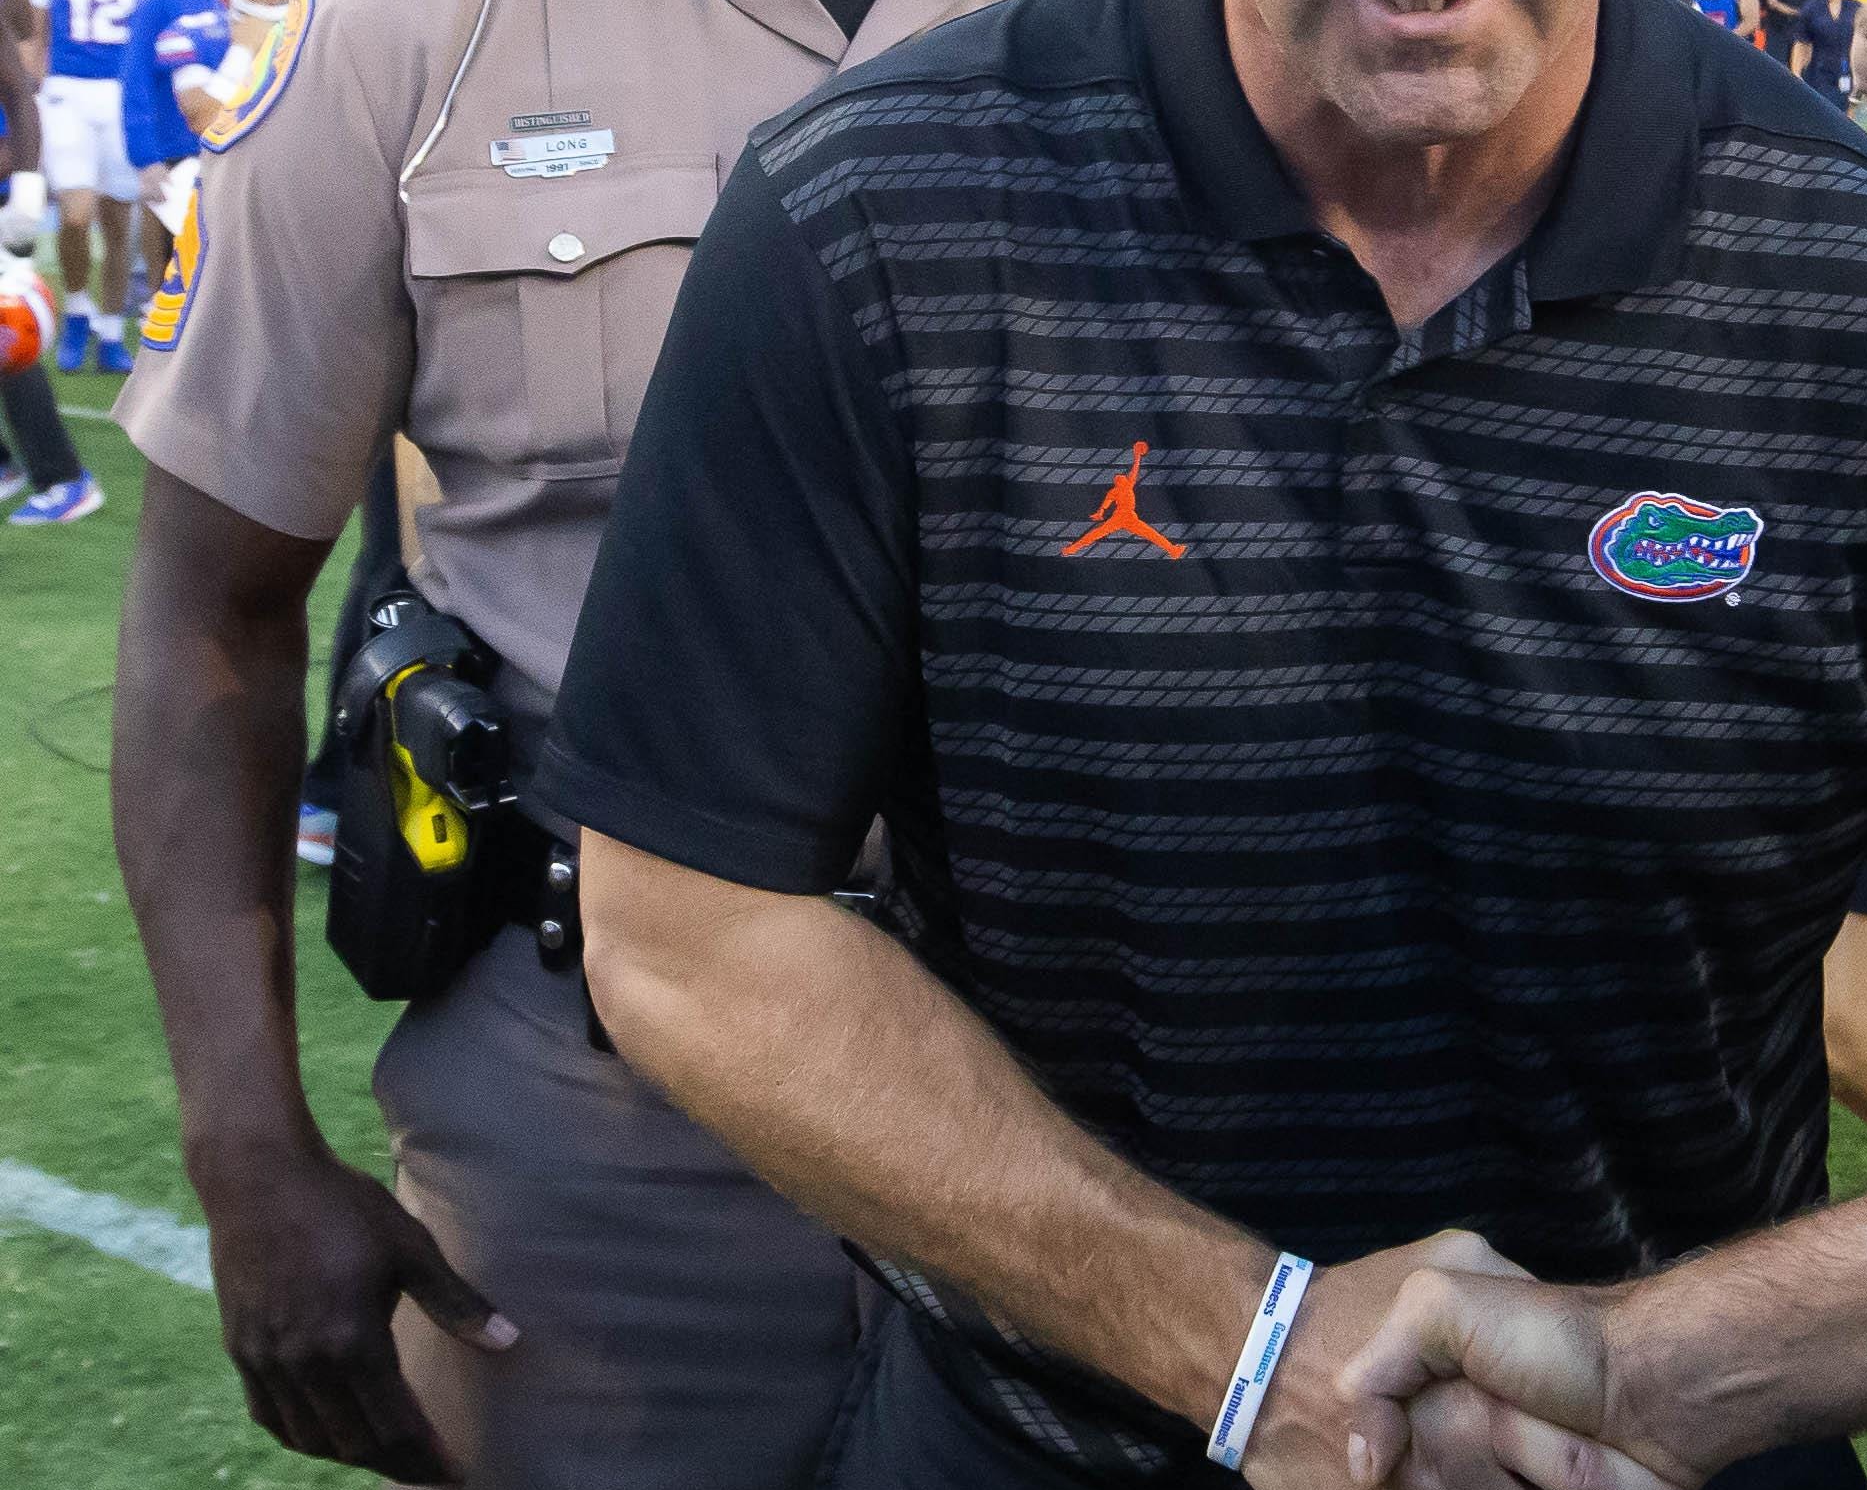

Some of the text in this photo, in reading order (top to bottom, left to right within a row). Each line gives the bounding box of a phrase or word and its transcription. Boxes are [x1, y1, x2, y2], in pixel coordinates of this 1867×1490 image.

[512, 112, 590, 128] DISTINGUISHED
[545, 138, 588, 152] LONG
[1263, 1263, 1293, 1317] Kindness
[1253, 1321, 1287, 1386] Goodness
[1215, 1376, 1250, 1448] Faithfulness
